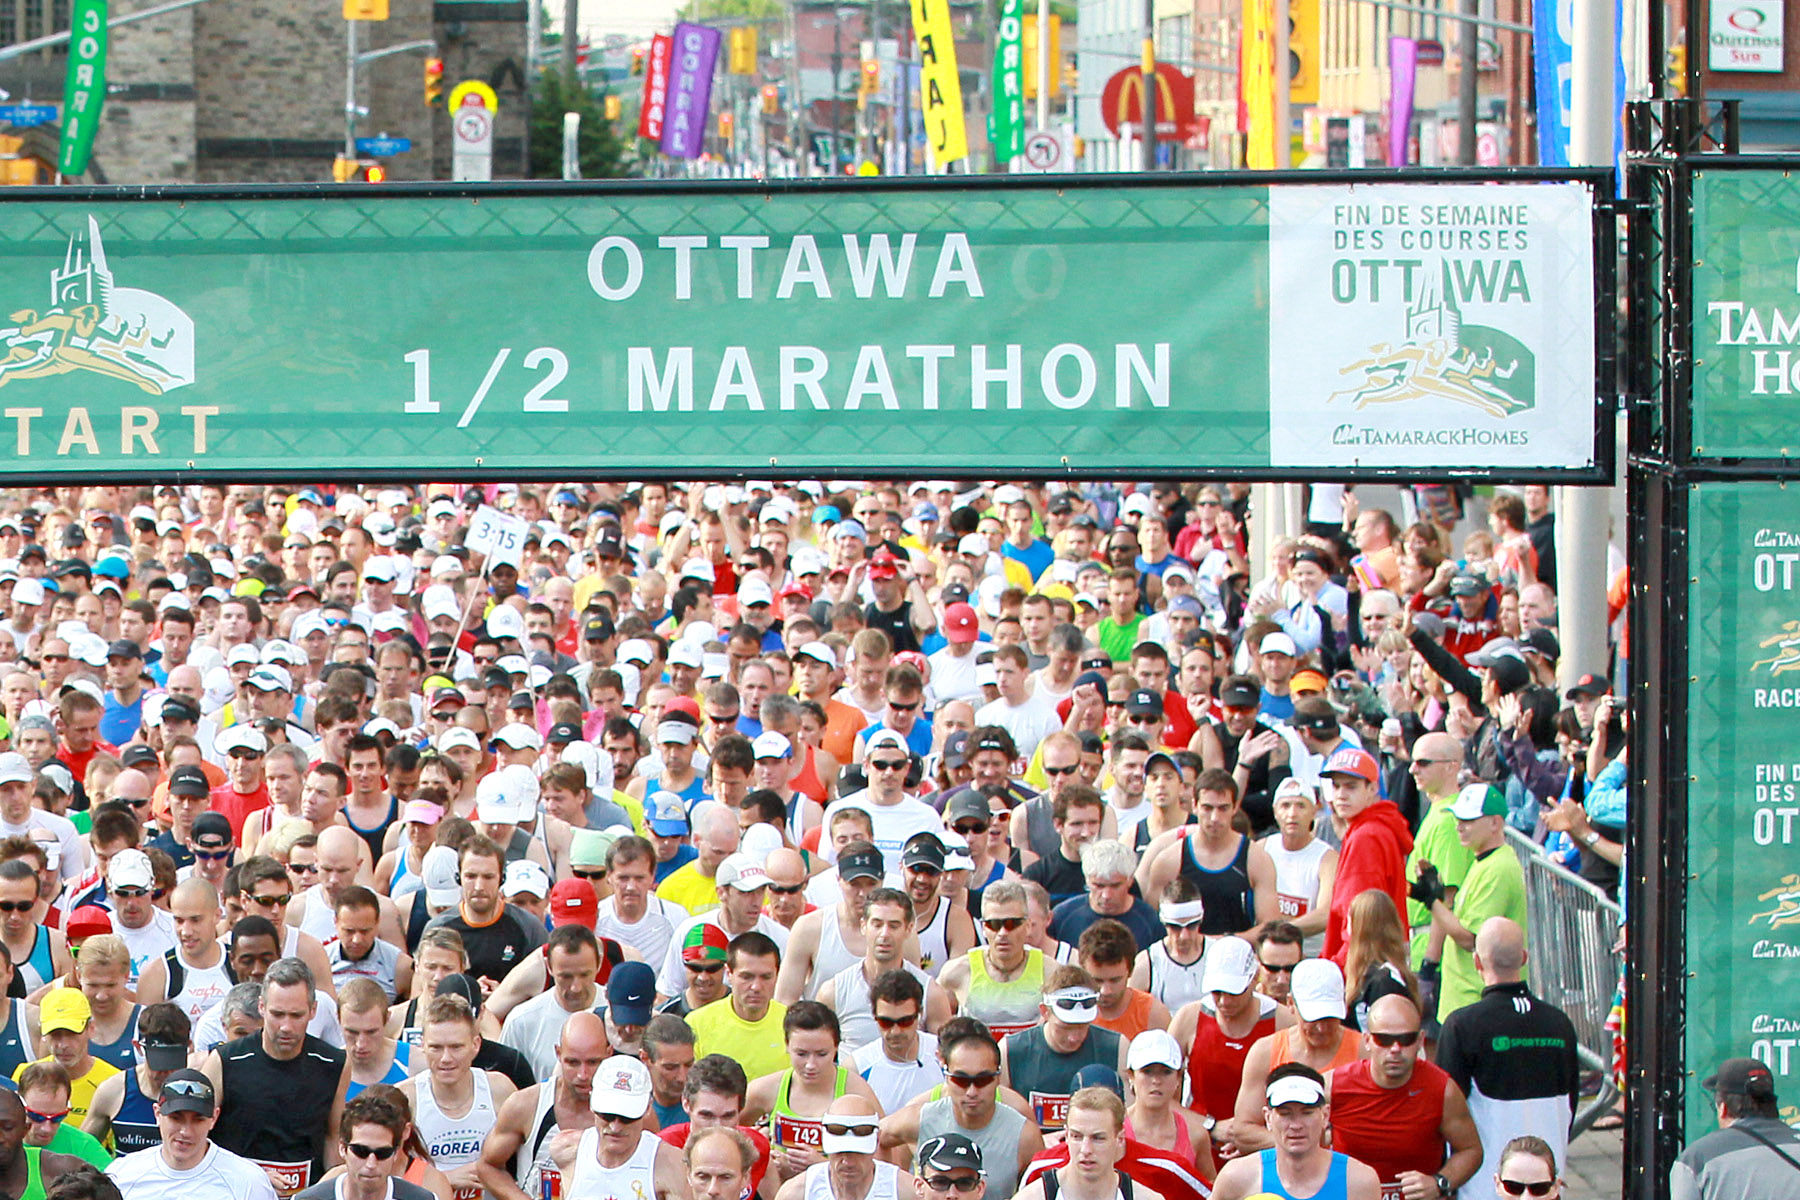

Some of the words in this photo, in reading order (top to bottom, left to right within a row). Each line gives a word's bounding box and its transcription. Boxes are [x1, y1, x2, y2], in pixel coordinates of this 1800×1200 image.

[1334, 206, 1373, 226] FIN
[1381, 206, 1410, 226] DE
[1420, 205, 1528, 226] SEMAINE
[1334, 230, 1384, 250] DES
[1400, 229, 1528, 250] COURSES
[588, 233, 984, 301] OTTAWA
[404, 346, 569, 428] 1/2
[628, 343, 1170, 412] MARATHON
[477, 521, 517, 549] 3:15
[1756, 765, 1784, 782] FIN
[1756, 785, 1795, 802] DES
[1511, 1037, 1565, 1049] SPORTSTATS
[793, 1127, 819, 1144] 742
